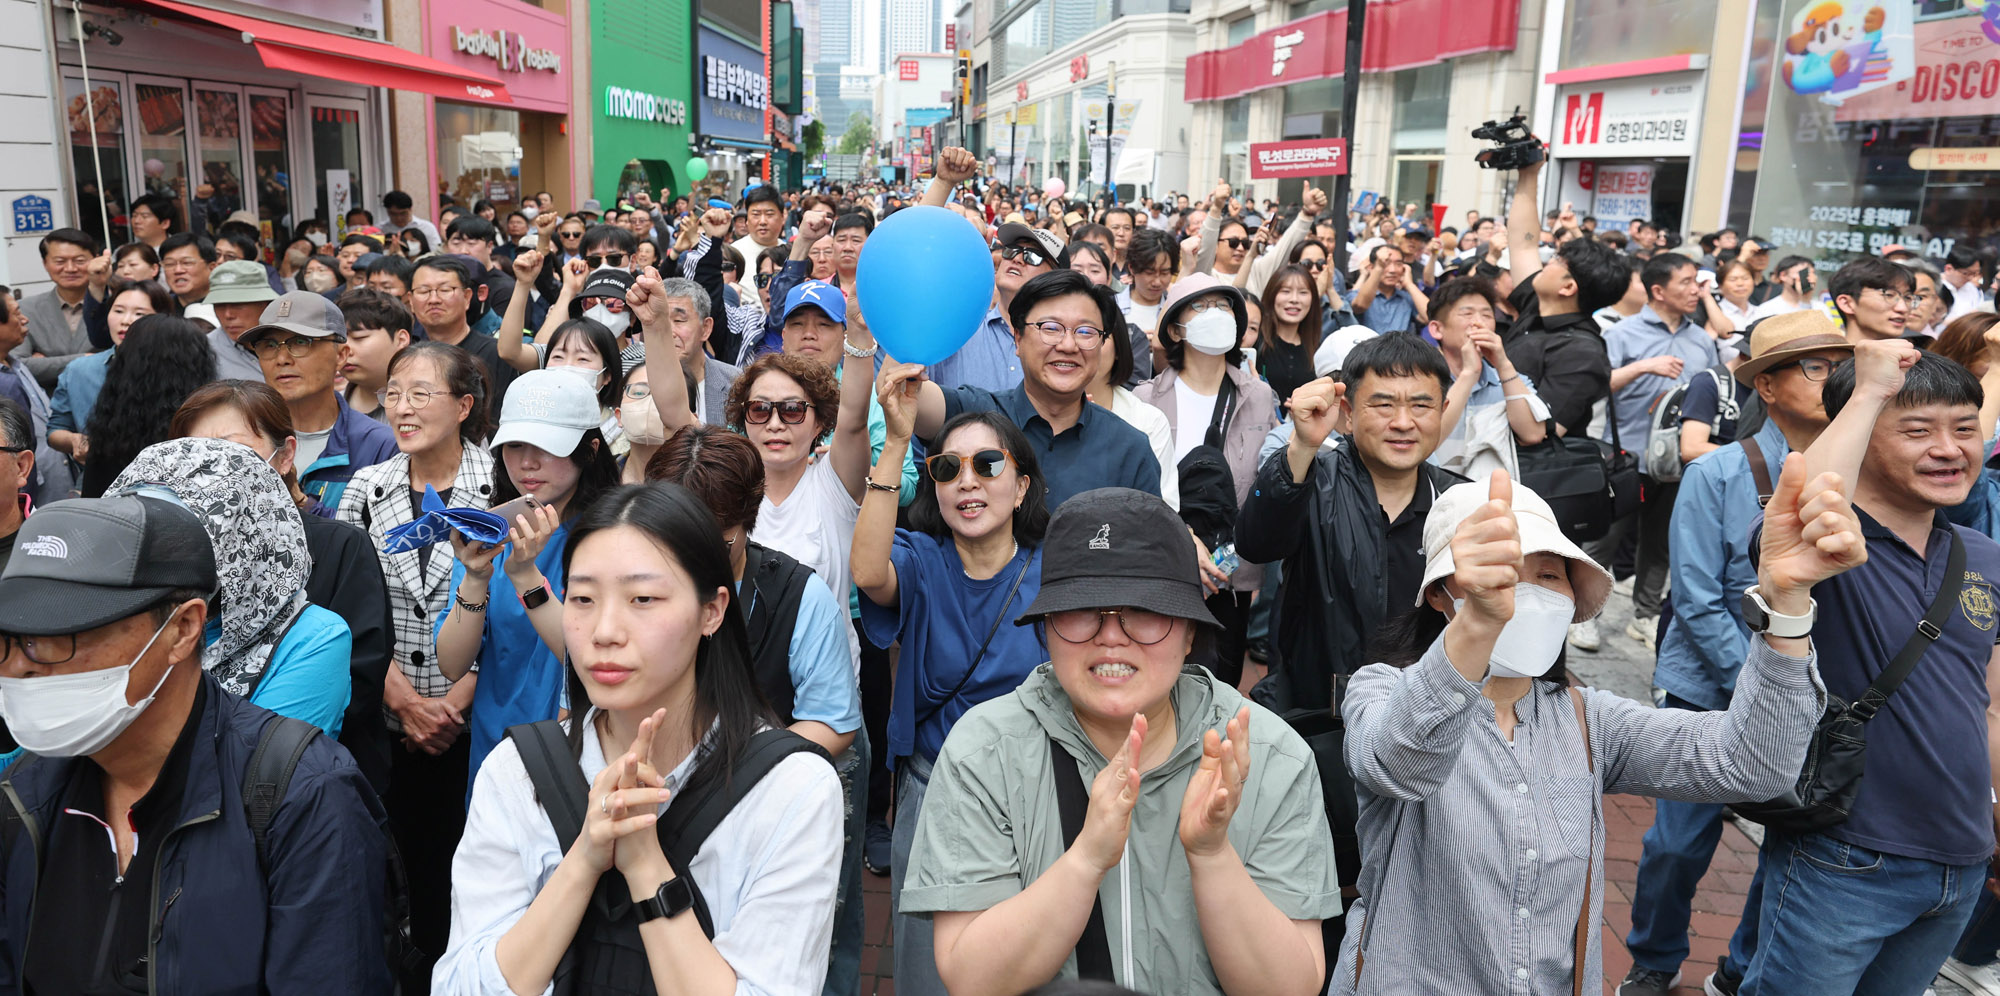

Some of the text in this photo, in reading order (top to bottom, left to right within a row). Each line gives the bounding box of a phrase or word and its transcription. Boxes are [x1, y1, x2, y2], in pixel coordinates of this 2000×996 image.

[455, 25, 499, 60] baskin
[527, 47, 561, 75] robbins
[606, 84, 686, 126] momocase
[1606, 119, 1688, 143] 성형외과의원
[1598, 171, 1650, 194] 임대문의
[16, 212, 51, 229] 31-3
[1809, 206, 1861, 225] 2025년
[1770, 226, 1813, 248] 갤럭시
[1815, 230, 1865, 253] S25로
[1925, 237, 1956, 259] AI
